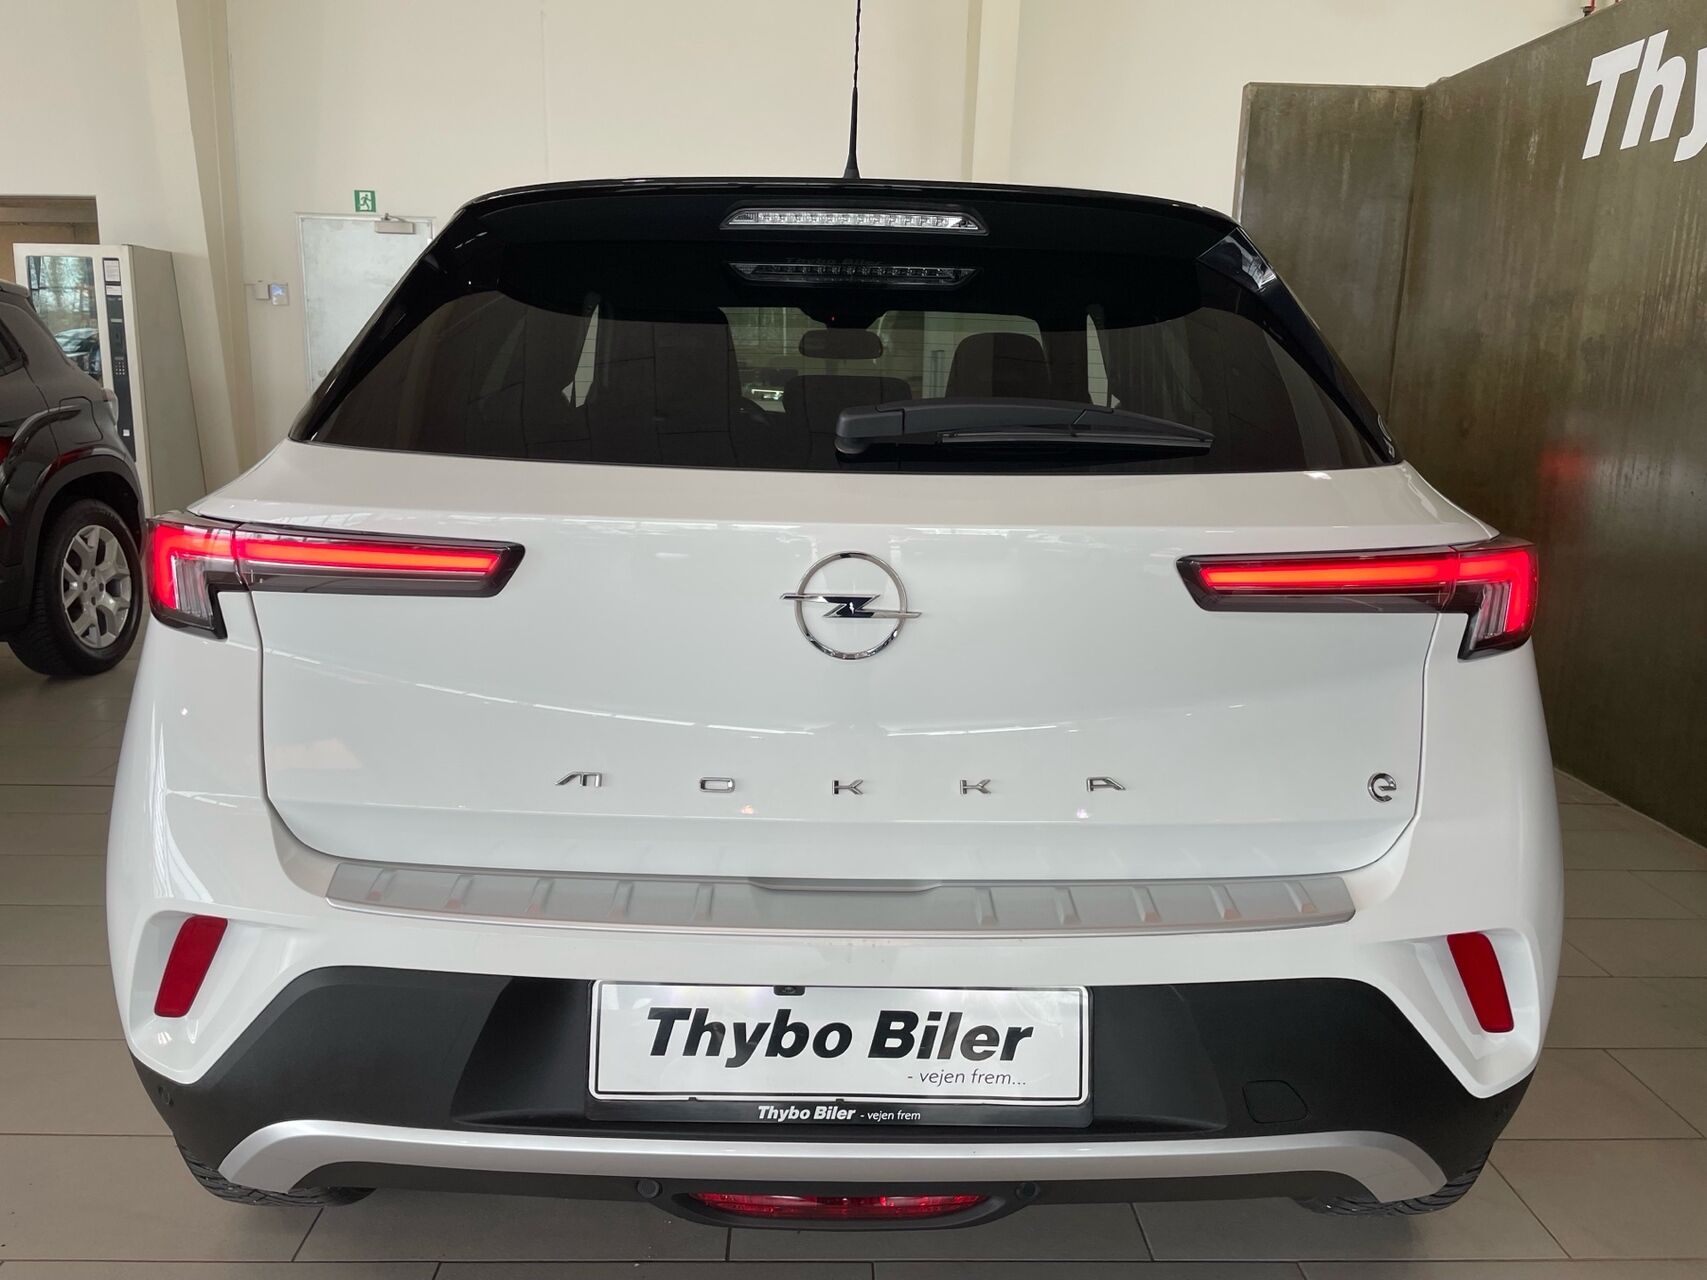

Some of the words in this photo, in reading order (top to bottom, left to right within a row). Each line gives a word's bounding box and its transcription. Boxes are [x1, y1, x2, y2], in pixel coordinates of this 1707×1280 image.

[647, 1006, 853, 1069] Thybo
[867, 1009, 1034, 1062] Biler
[919, 1068, 966, 1087] vejen
[971, 1067, 1027, 1087] frem...
[758, 1105, 810, 1122] Thybo
[813, 1105, 856, 1120] Biler
[867, 1111, 895, 1122] vejen
[897, 1109, 921, 1120] frem
